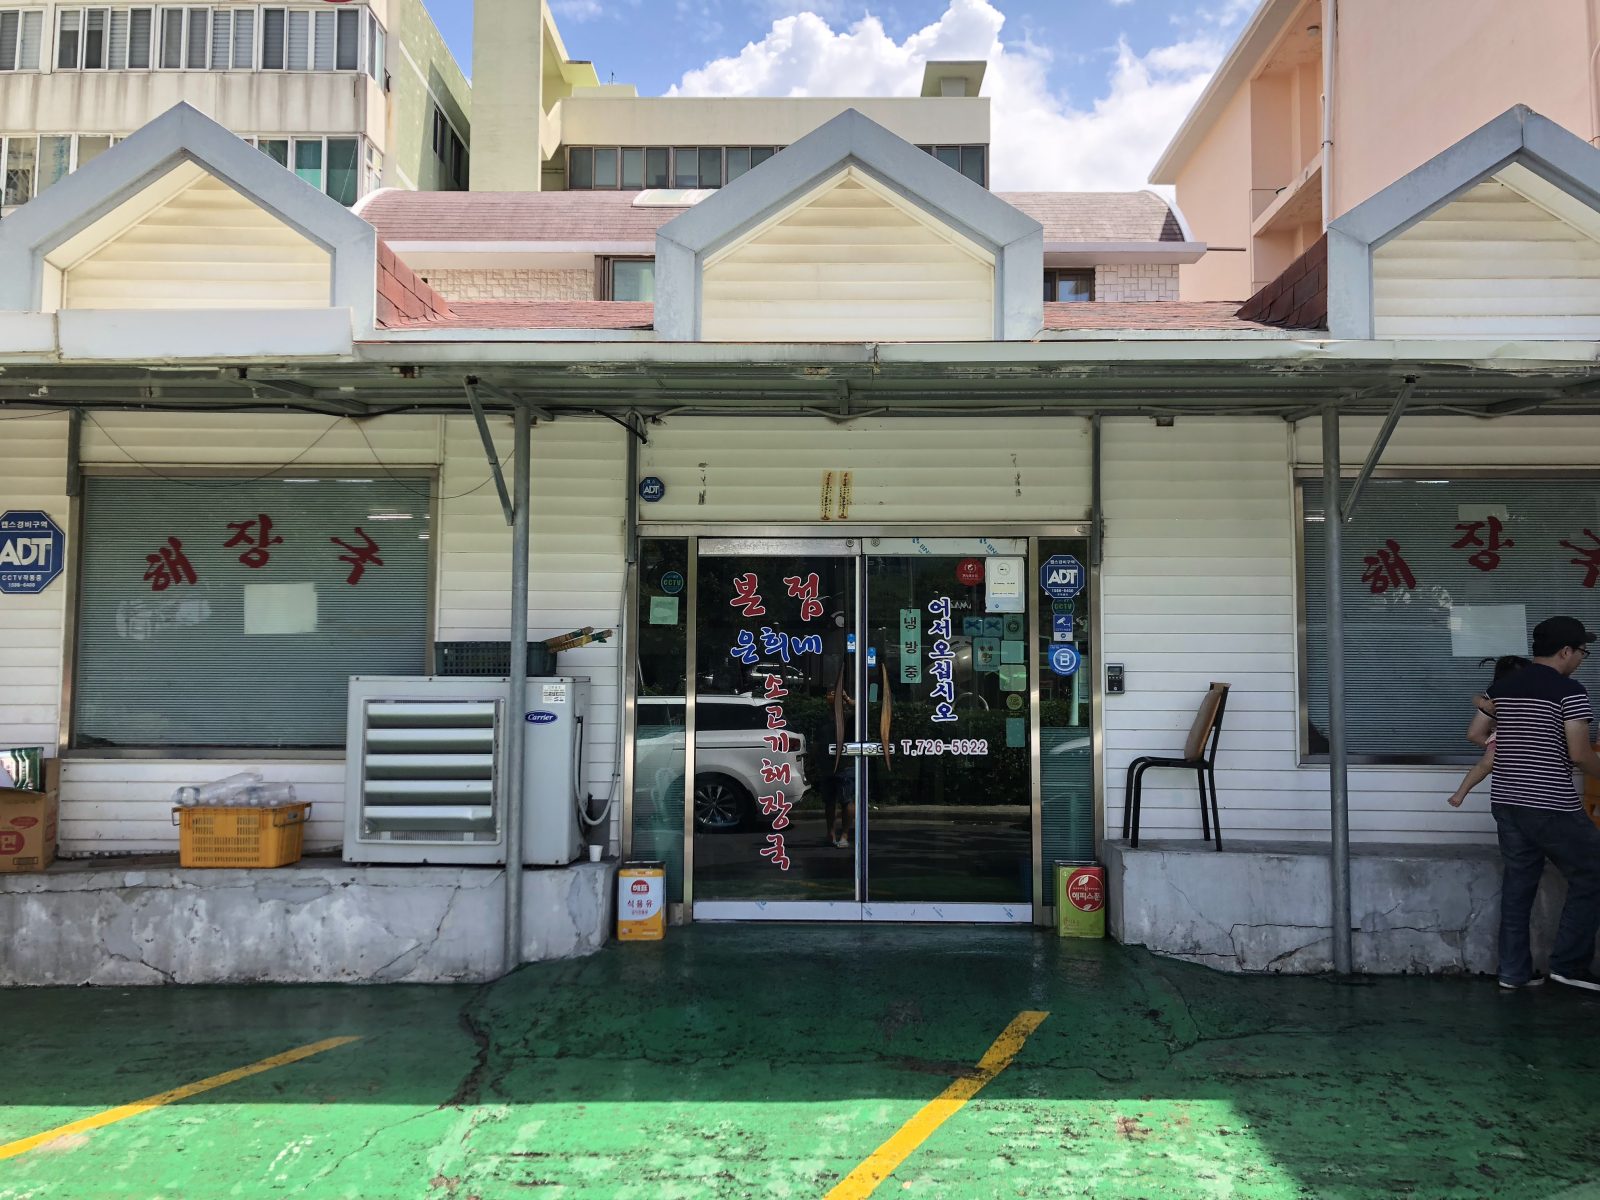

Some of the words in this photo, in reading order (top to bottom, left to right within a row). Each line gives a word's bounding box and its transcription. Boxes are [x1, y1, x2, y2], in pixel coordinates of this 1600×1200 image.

[644, 485, 660, 494] ADT
[0, 538, 52, 565] ADT
[1048, 569, 1078, 584] ADT
[730, 627, 823, 664] 은희네
[903, 616, 918, 680] 냉방중
[928, 597, 958, 722] 어서오십시오
[527, 713, 555, 721] Carrier
[901, 738, 988, 757] T.726-5622
[758, 674, 793, 871] 소고기해장국
